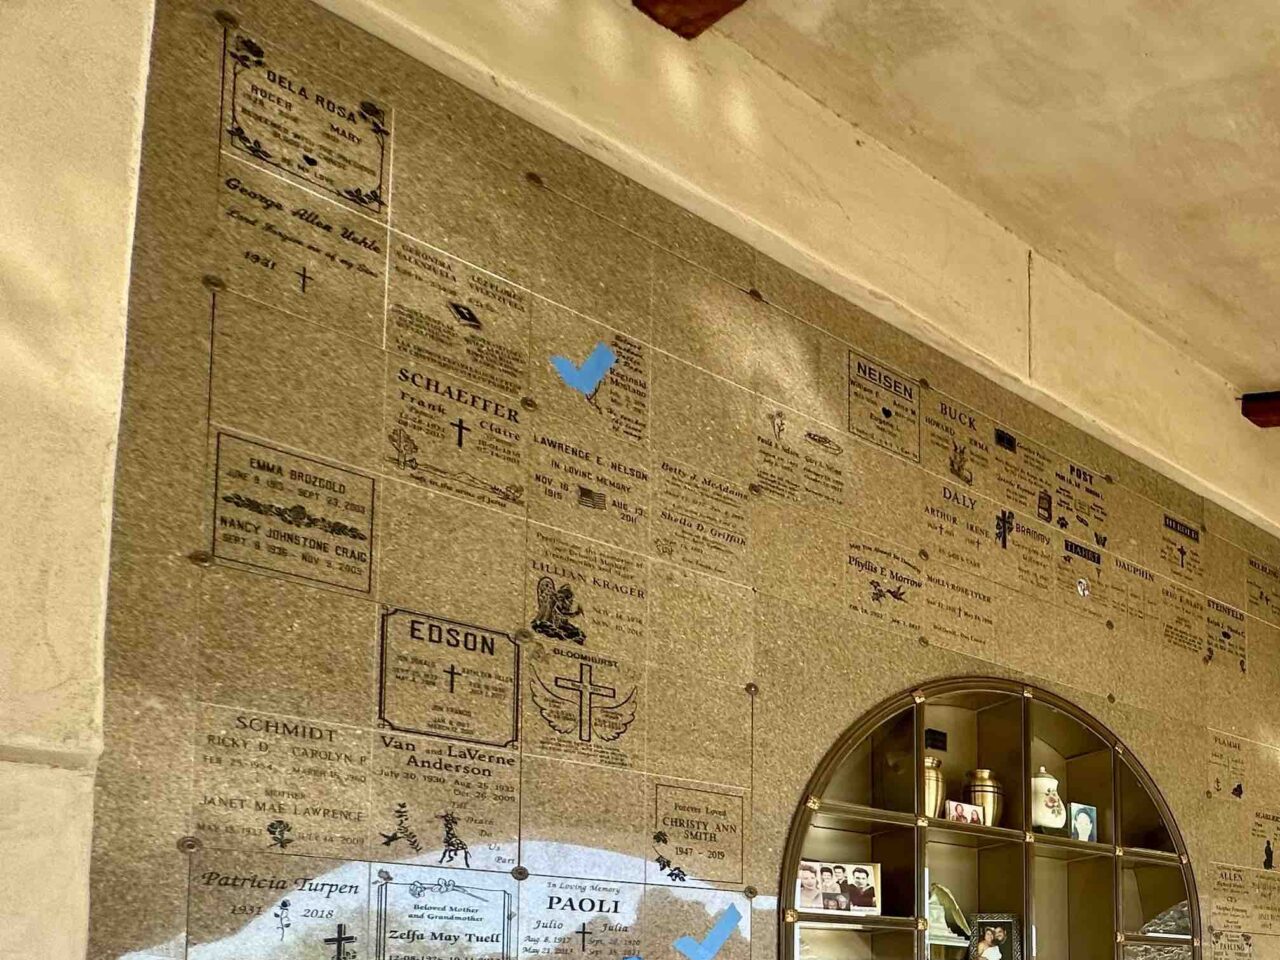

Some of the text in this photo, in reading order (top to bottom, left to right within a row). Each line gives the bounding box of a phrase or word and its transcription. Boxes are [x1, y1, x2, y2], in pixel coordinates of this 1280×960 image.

[267, 70, 357, 124] DELA ROSA
[857, 360, 913, 400] NEISEN
[398, 368, 520, 424] SCHAEFFER
[400, 390, 447, 415] Frank
[925, 415, 955, 437] HOWARD
[940, 402, 976, 431] BUCK
[479, 420, 520, 442] Claire
[534, 434, 649, 481] LAWRENCE NELSON
[250, 457, 347, 496] EMMA BROZGOLD
[661, 462, 688, 480] Betty
[702, 477, 749, 501] McAdams
[1067, 463, 1094, 486] POST
[943, 486, 977, 510] DALY
[661, 511, 746, 547] Sheila Griffith
[924, 505, 990, 539] ARTHUR IRENE
[220, 515, 368, 564] NANCY JOHNSTONE CRAIG
[532, 560, 646, 600] LILLIAN KRAGER
[848, 555, 923, 590] Phyllis Morrow
[1115, 559, 1155, 583] DAUPHIN
[1207, 599, 1245, 622] STEINFELD
[410, 618, 496, 656] EDSON
[553, 647, 620, 669] BLOOMHURST
[236, 716, 339, 743] SCHMIDT
[207, 734, 353, 764] RICKY CAROLYN
[380, 735, 516, 766] Van and LaVerne
[406, 754, 493, 777] Anderson
[265, 789, 306, 800] MOTHER
[199, 796, 367, 822] JANET MAE LAWRENCE
[674, 802, 728, 817] Forever Loved
[662, 815, 738, 834] CHRISTY ANN
[683, 828, 718, 843] SMITH
[675, 846, 726, 861] 1947 2019
[200, 871, 361, 899] Patricia Turpen
[1219, 871, 1243, 882] ALLEN
[559, 882, 621, 896] Loving Memory
[302, 908, 335, 920] 2018
[413, 903, 480, 914] Beloved Mother
[546, 895, 622, 914] PAOLI
[427, 914, 485, 923] Grandmother
[533, 919, 564, 931] Julio
[601, 923, 630, 934] Julia
[388, 930, 502, 946] Zelfa May Tuell
